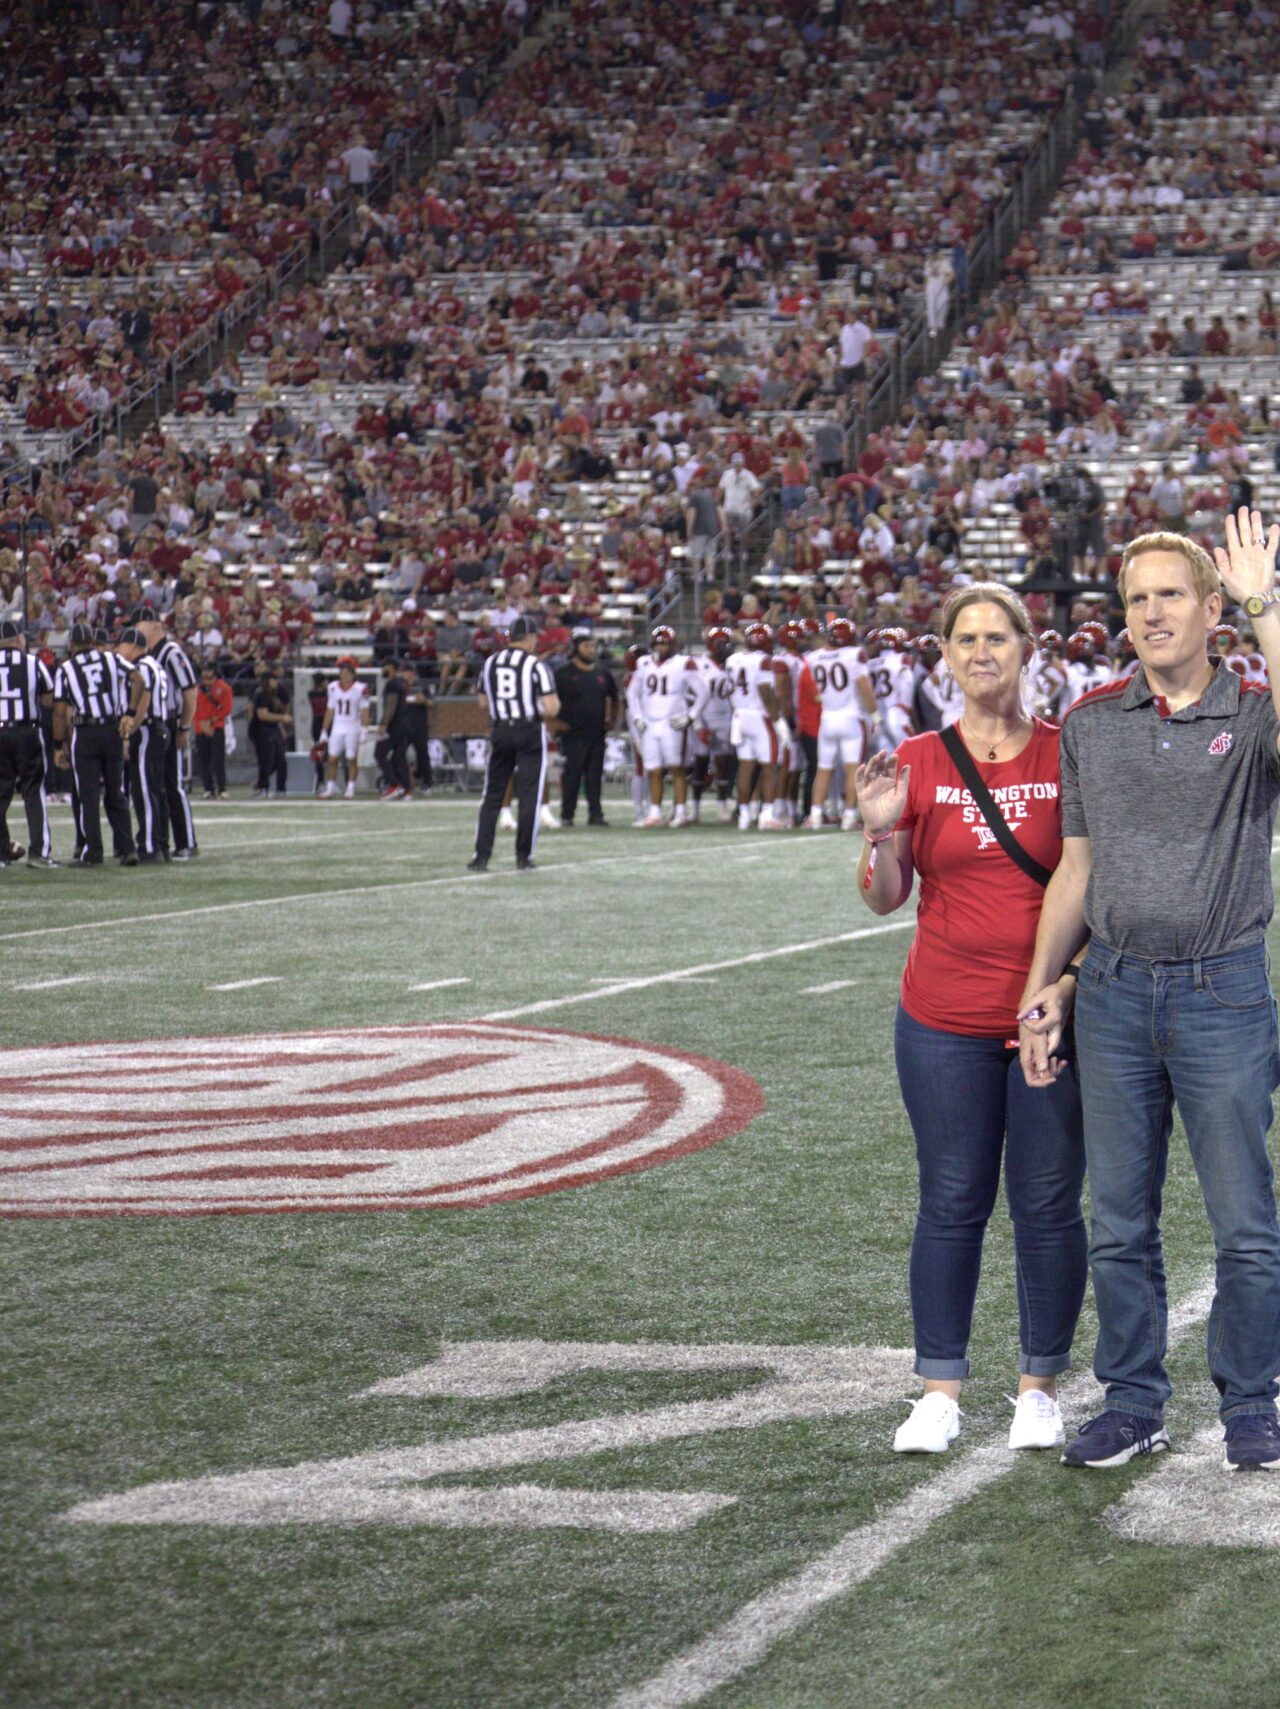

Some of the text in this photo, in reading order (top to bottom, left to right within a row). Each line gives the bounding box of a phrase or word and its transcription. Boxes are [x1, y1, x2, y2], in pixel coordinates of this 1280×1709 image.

[0, 667, 21, 698] L
[82, 663, 104, 694] F
[496, 667, 517, 699] B
[647, 674, 668, 695] 91
[814, 662, 849, 692] 90
[337, 699, 351, 716] 11
[935, 782, 1058, 805] WASNGTON
